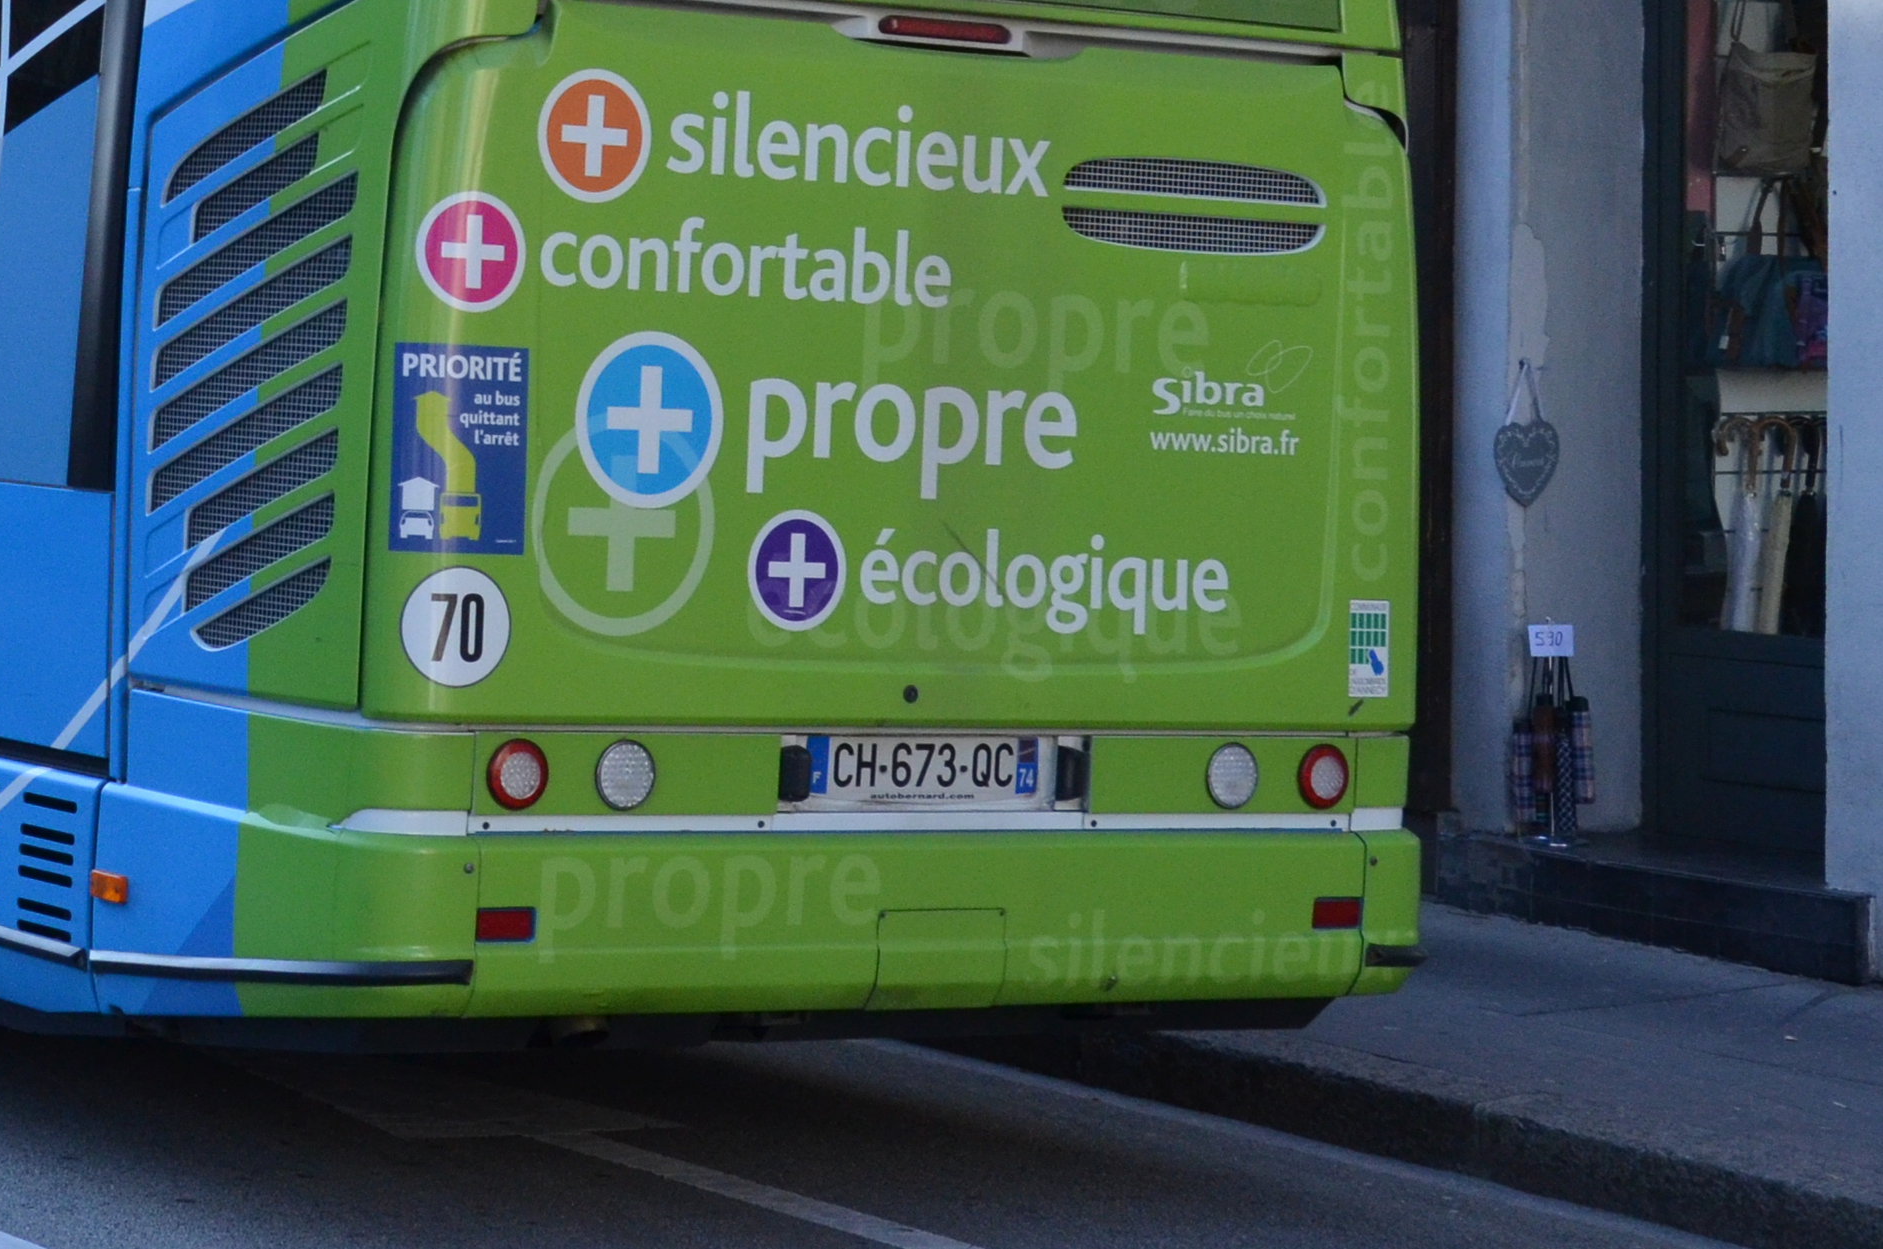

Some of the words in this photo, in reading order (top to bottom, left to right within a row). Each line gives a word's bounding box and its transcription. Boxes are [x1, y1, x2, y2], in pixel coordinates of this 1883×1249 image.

[666, 90, 1051, 198] silencieux
[539, 216, 953, 309] confortable
[402, 352, 522, 382] PRIORITÉ
[474, 393, 492, 406] au
[495, 390, 521, 407] bus
[459, 410, 520, 428] quittant
[474, 429, 520, 447] l'arrêt
[745, 377, 1078, 501] propre
[1150, 426, 1300, 456] www.sibra.fr
[859, 527, 1230, 636] écologique
[430, 592, 483, 663] 70
[812, 771, 821, 784] F
[1018, 767, 1035, 788] 74
[869, 791, 975, 801] autobernard.com
[536, 848, 884, 962] propre
